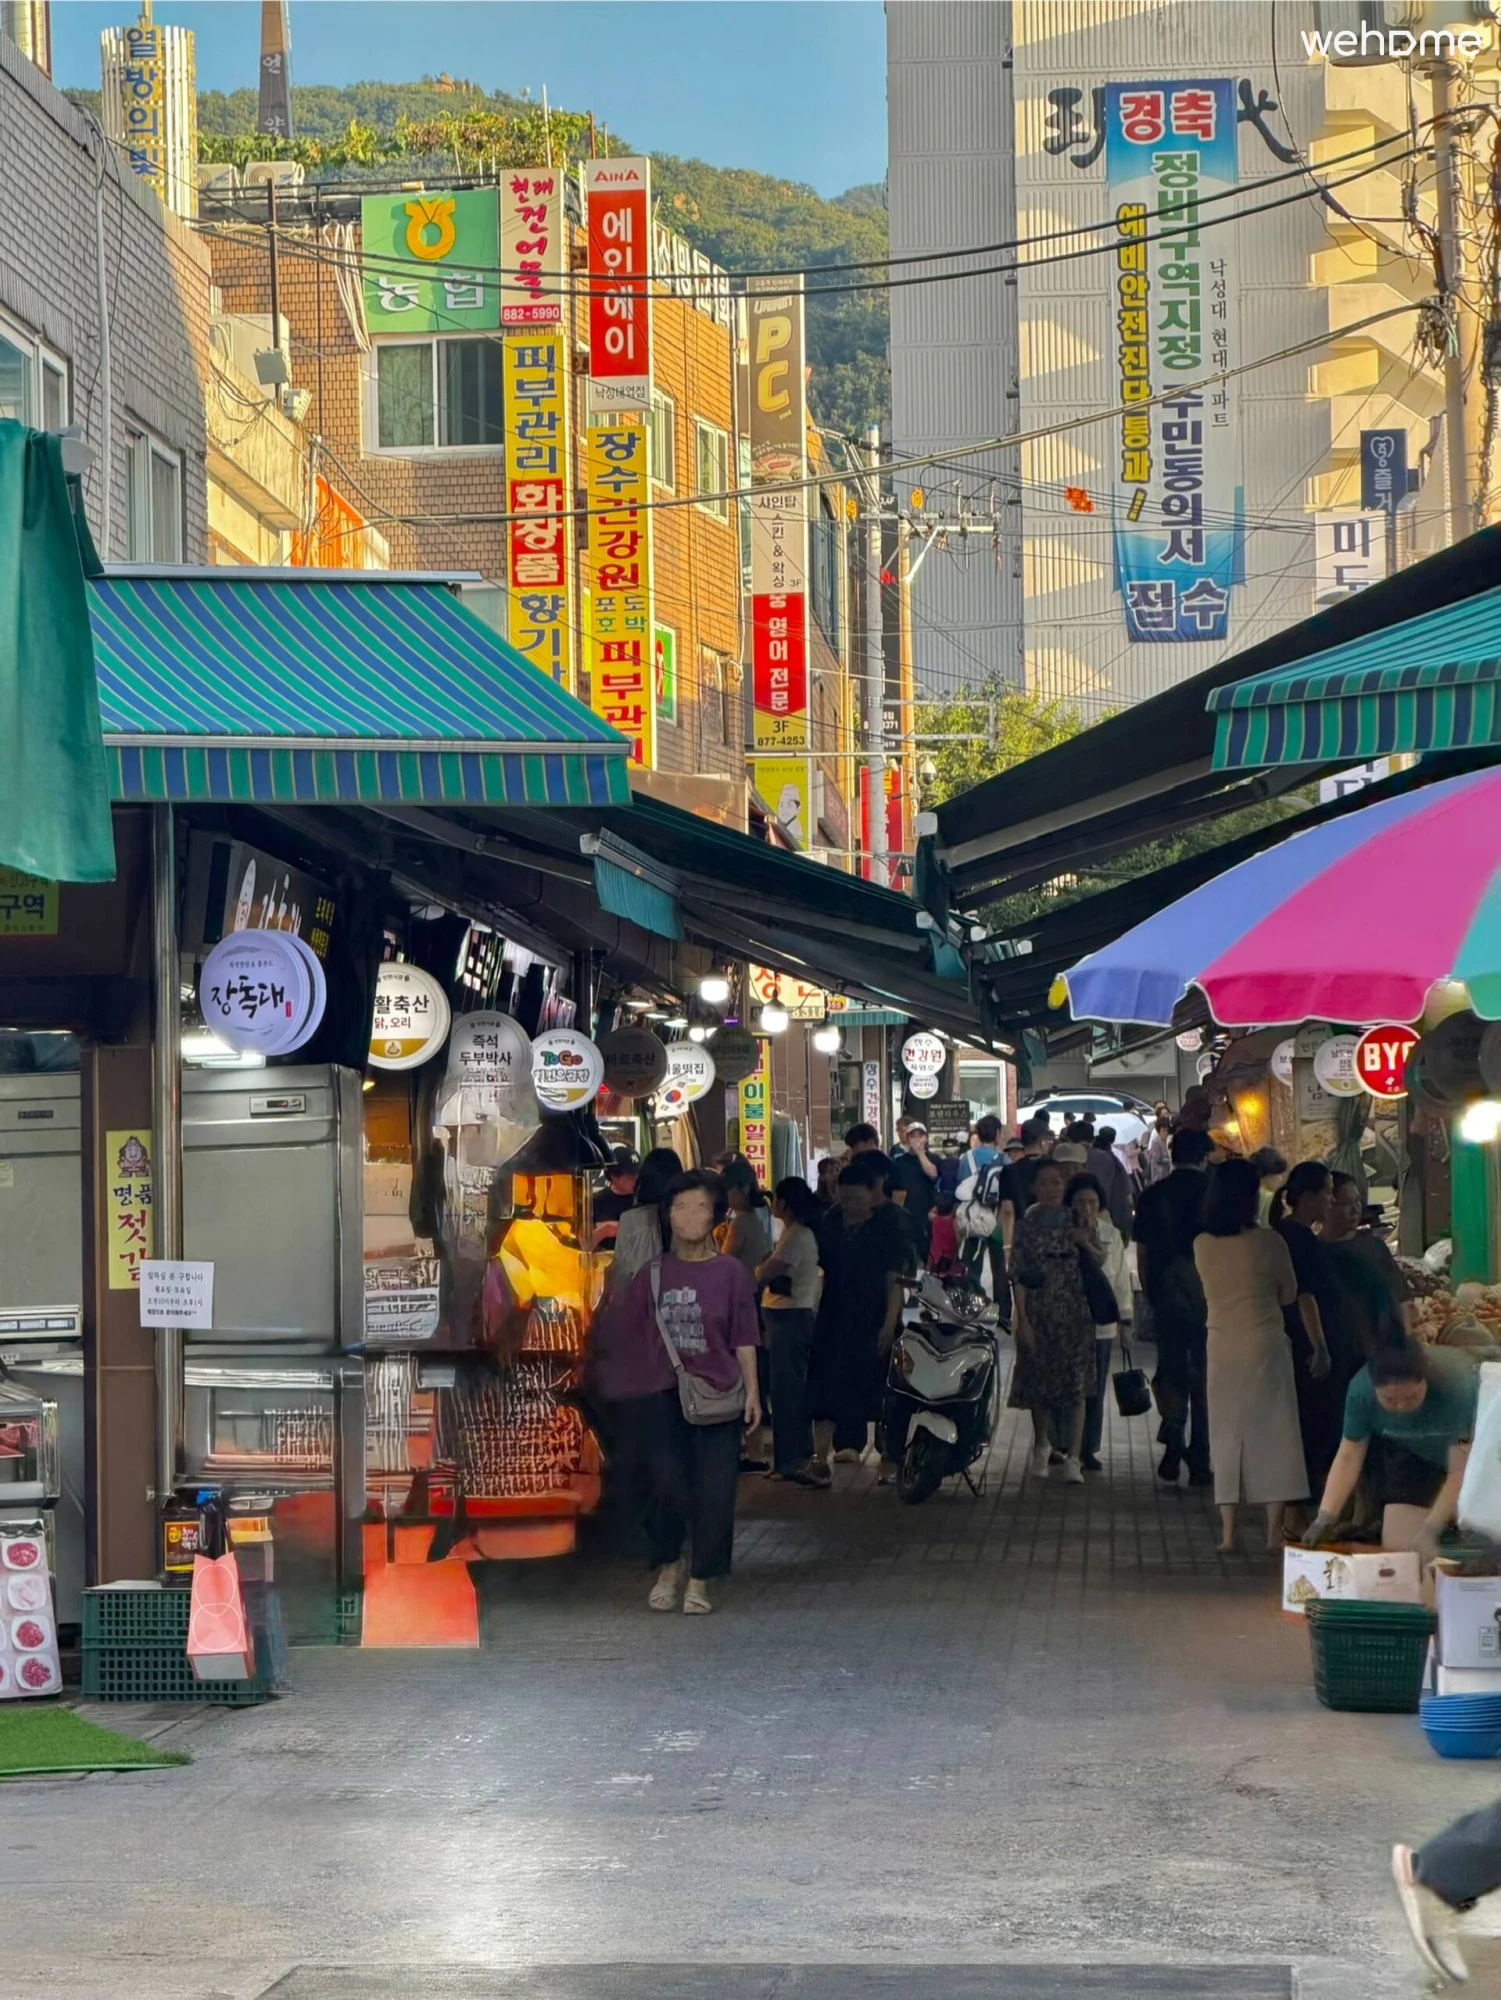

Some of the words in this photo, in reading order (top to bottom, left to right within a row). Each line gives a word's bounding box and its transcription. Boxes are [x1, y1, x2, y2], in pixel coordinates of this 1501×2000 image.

[1120, 92, 1215, 143] 경축
[594, 168, 640, 188] AINA
[514, 204, 550, 301] 건어물
[1155, 152, 1202, 371] 정비구역지정
[377, 272, 486, 313] 농협
[602, 207, 635, 360] 에이에이
[1209, 258, 1228, 320] 낙성대
[503, 306, 560, 321] 882-5990
[512, 345, 562, 474] 피부관리
[1158, 384, 1204, 563] 주민동의서
[513, 484, 564, 584] 화장품
[790, 579, 802, 588] 3F
[594, 595, 645, 612] 포도
[1127, 578, 1228, 632] 접수
[594, 616, 647, 634] 호박
[773, 721, 789, 733] 3F
[757, 736, 806, 747] 877-4253
[210, 975, 286, 1020] 장독대
[390, 1016, 411, 1029] 오리
[472, 1033, 499, 1049] 즉석
[459, 1051, 513, 1066] 두부박사
[903, 1049, 942, 1062] 건강원
[113, 1183, 152, 1206] 명품
[178, 1272, 204, 1282] 구합니다
